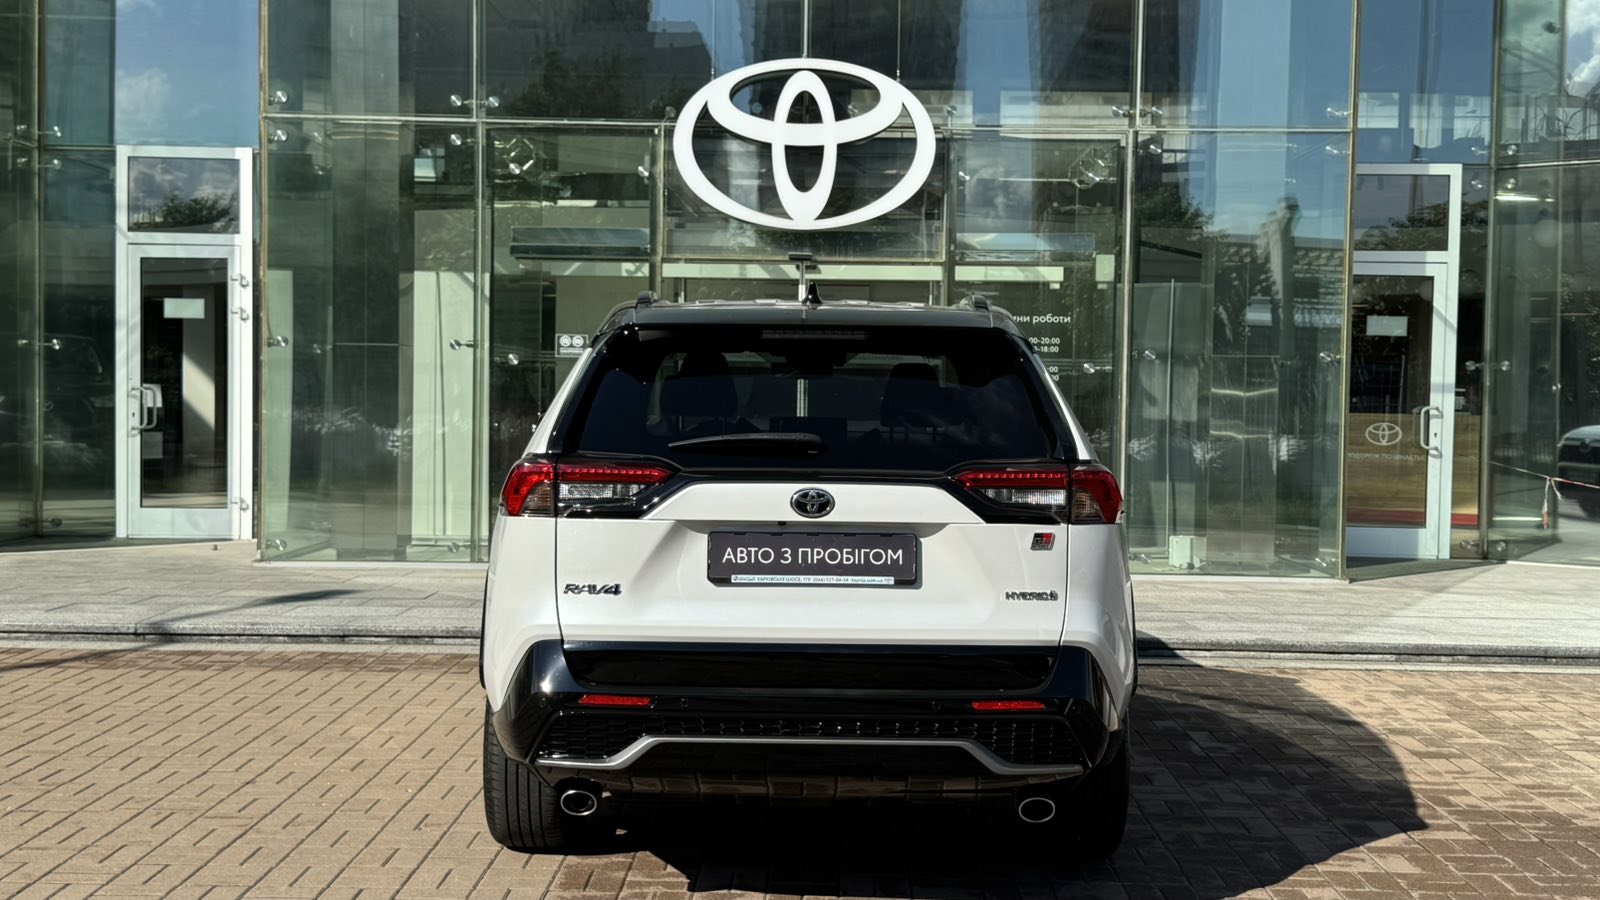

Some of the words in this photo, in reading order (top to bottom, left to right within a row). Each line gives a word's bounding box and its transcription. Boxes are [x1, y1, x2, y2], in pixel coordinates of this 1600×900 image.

[1032, 313, 1071, 324] роботи
[722, 547, 775, 564] АВТО
[798, 547, 904, 565] ПРОБІГОМ
[563, 583, 622, 596] RAV4
[1005, 591, 1048, 601] HYBRID
